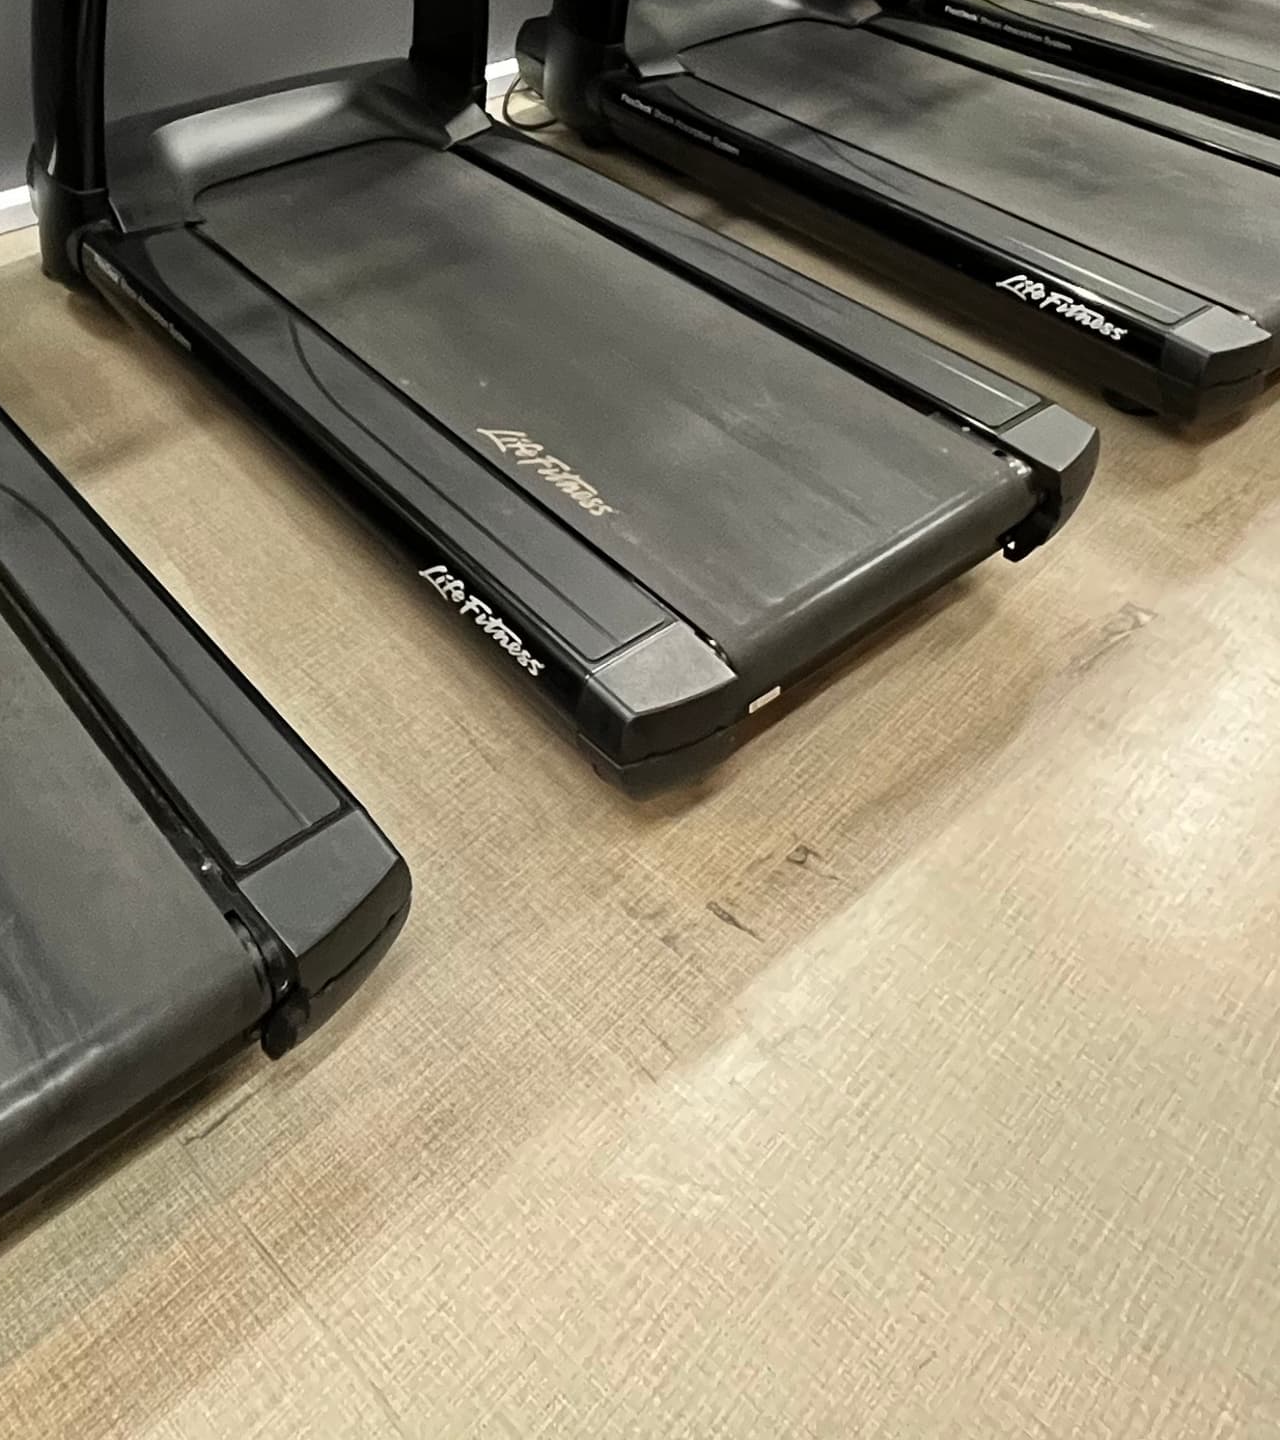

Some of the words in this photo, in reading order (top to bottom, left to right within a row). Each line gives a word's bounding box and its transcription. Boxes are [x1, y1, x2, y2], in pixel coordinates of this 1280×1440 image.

[995, 274, 1046, 301] Life
[1039, 291, 1128, 341] Fitness
[476, 428, 544, 457] Life
[517, 455, 614, 517] Fitness
[418, 565, 465, 602] Life
[459, 595, 546, 676] Fitness
